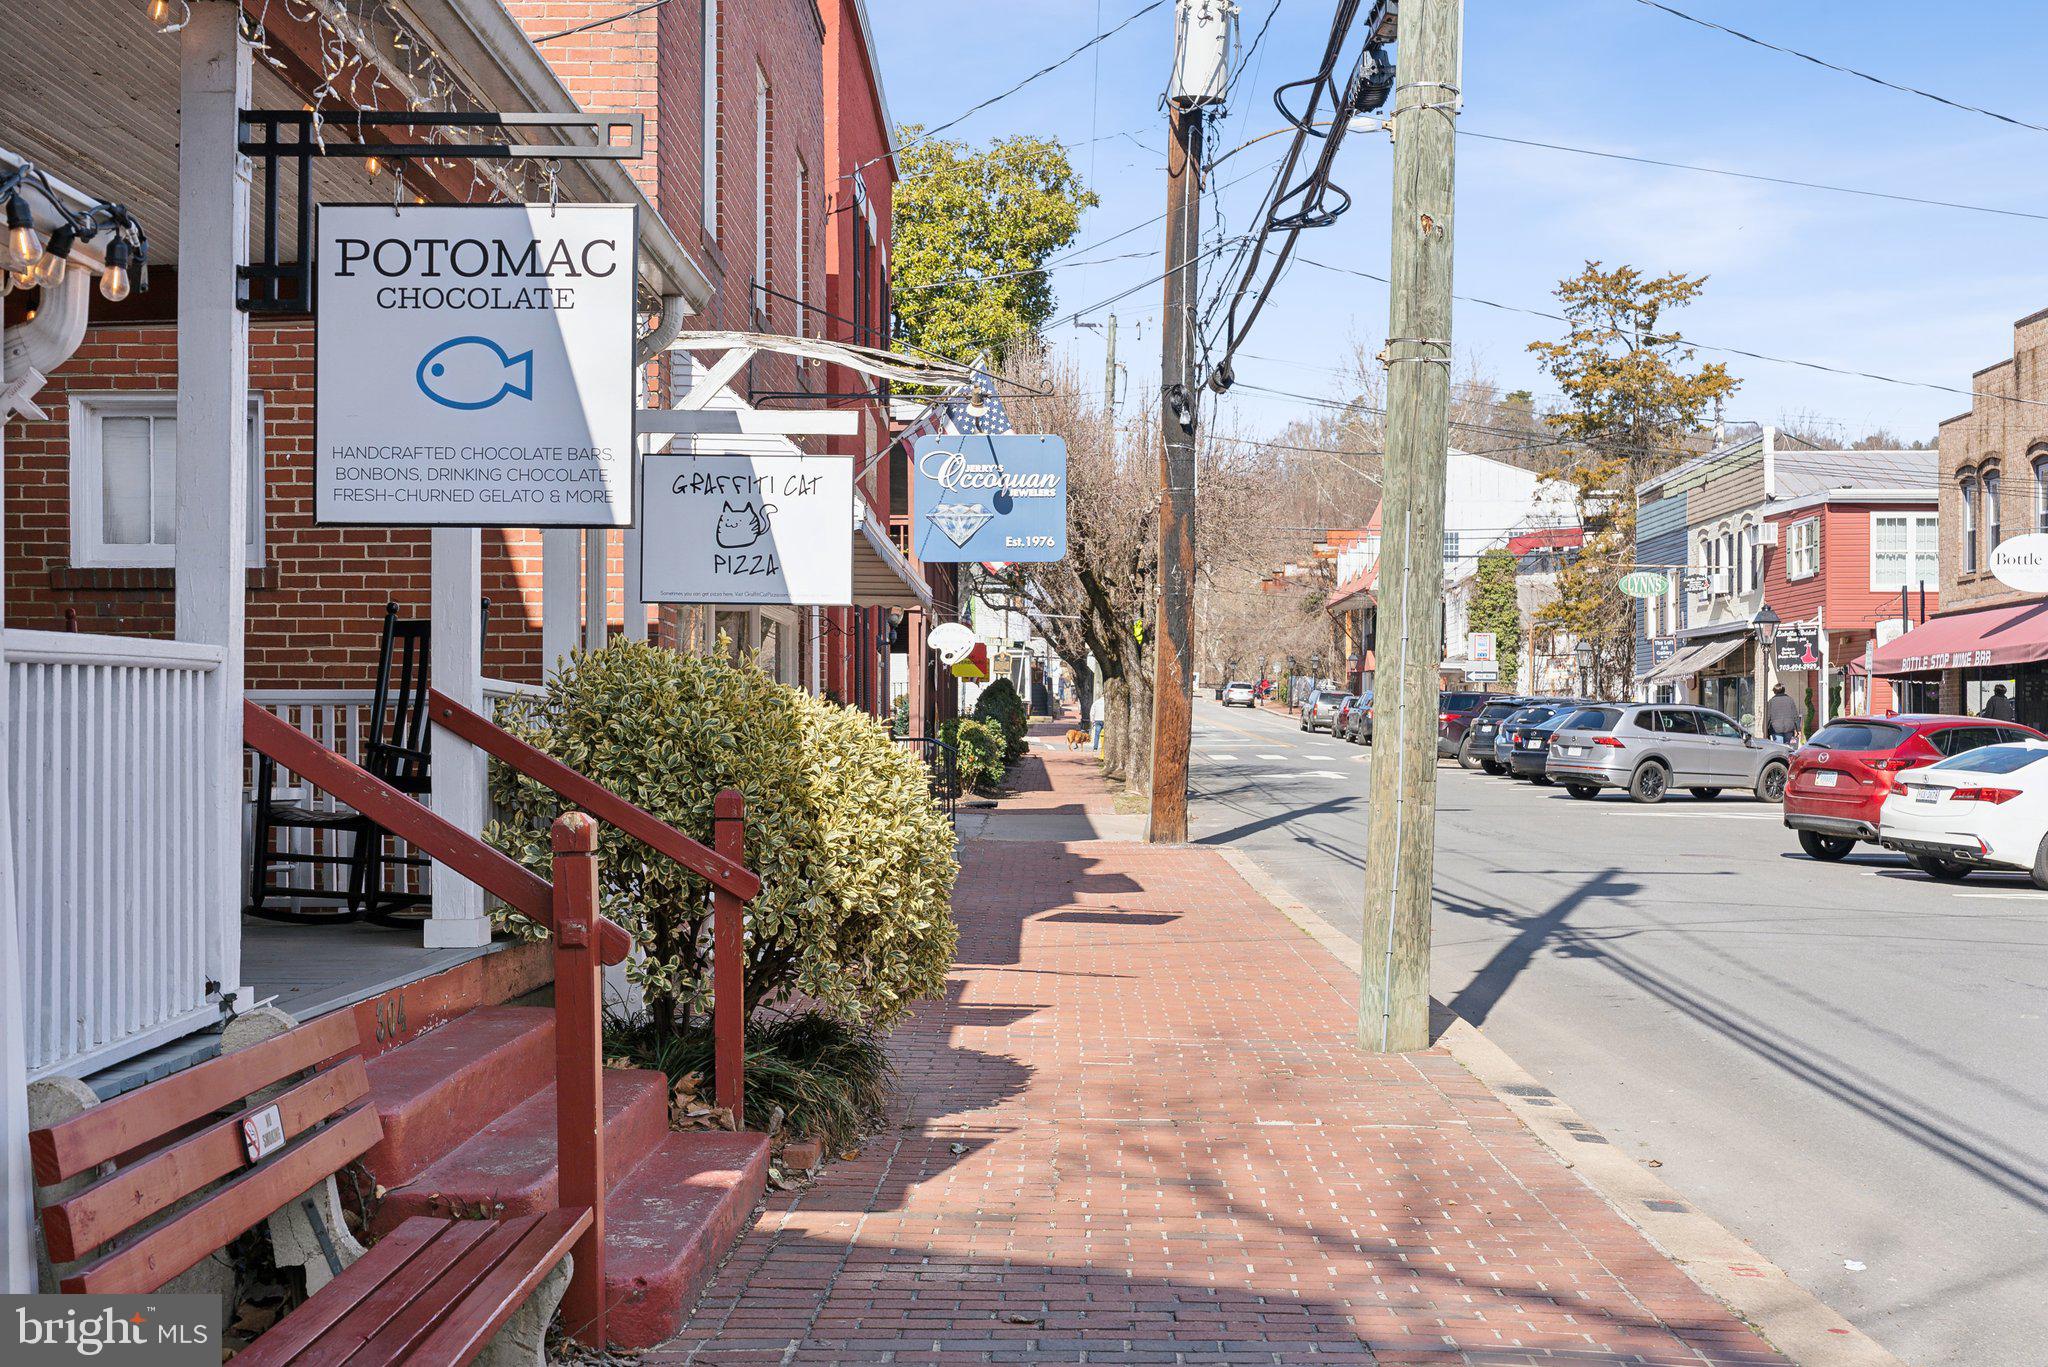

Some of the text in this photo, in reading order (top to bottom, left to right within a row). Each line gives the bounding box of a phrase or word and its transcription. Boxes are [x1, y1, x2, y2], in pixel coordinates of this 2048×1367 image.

[334, 238, 617, 277] POTOMAC
[376, 287, 575, 309] CHOCOLATE
[332, 446, 615, 462] HANDCRAFTED CHOCOLATE BARS,
[335, 467, 612, 483] BONBONS, DRINKING CHOCOLATE,
[919, 450, 1061, 497] Occoquan
[965, 464, 1004, 473] JERRY'S
[672, 472, 823, 497] GRAFFITI CAT
[1009, 488, 1057, 497] JEWELERS
[333, 488, 614, 503] FRESH-CHURNED GELATO & MORE
[714, 554, 779, 576] PIZZA
[1996, 553, 2043, 566] Bottle
[1901, 650, 1991, 671] BOTTLE STOP WINE BAR
